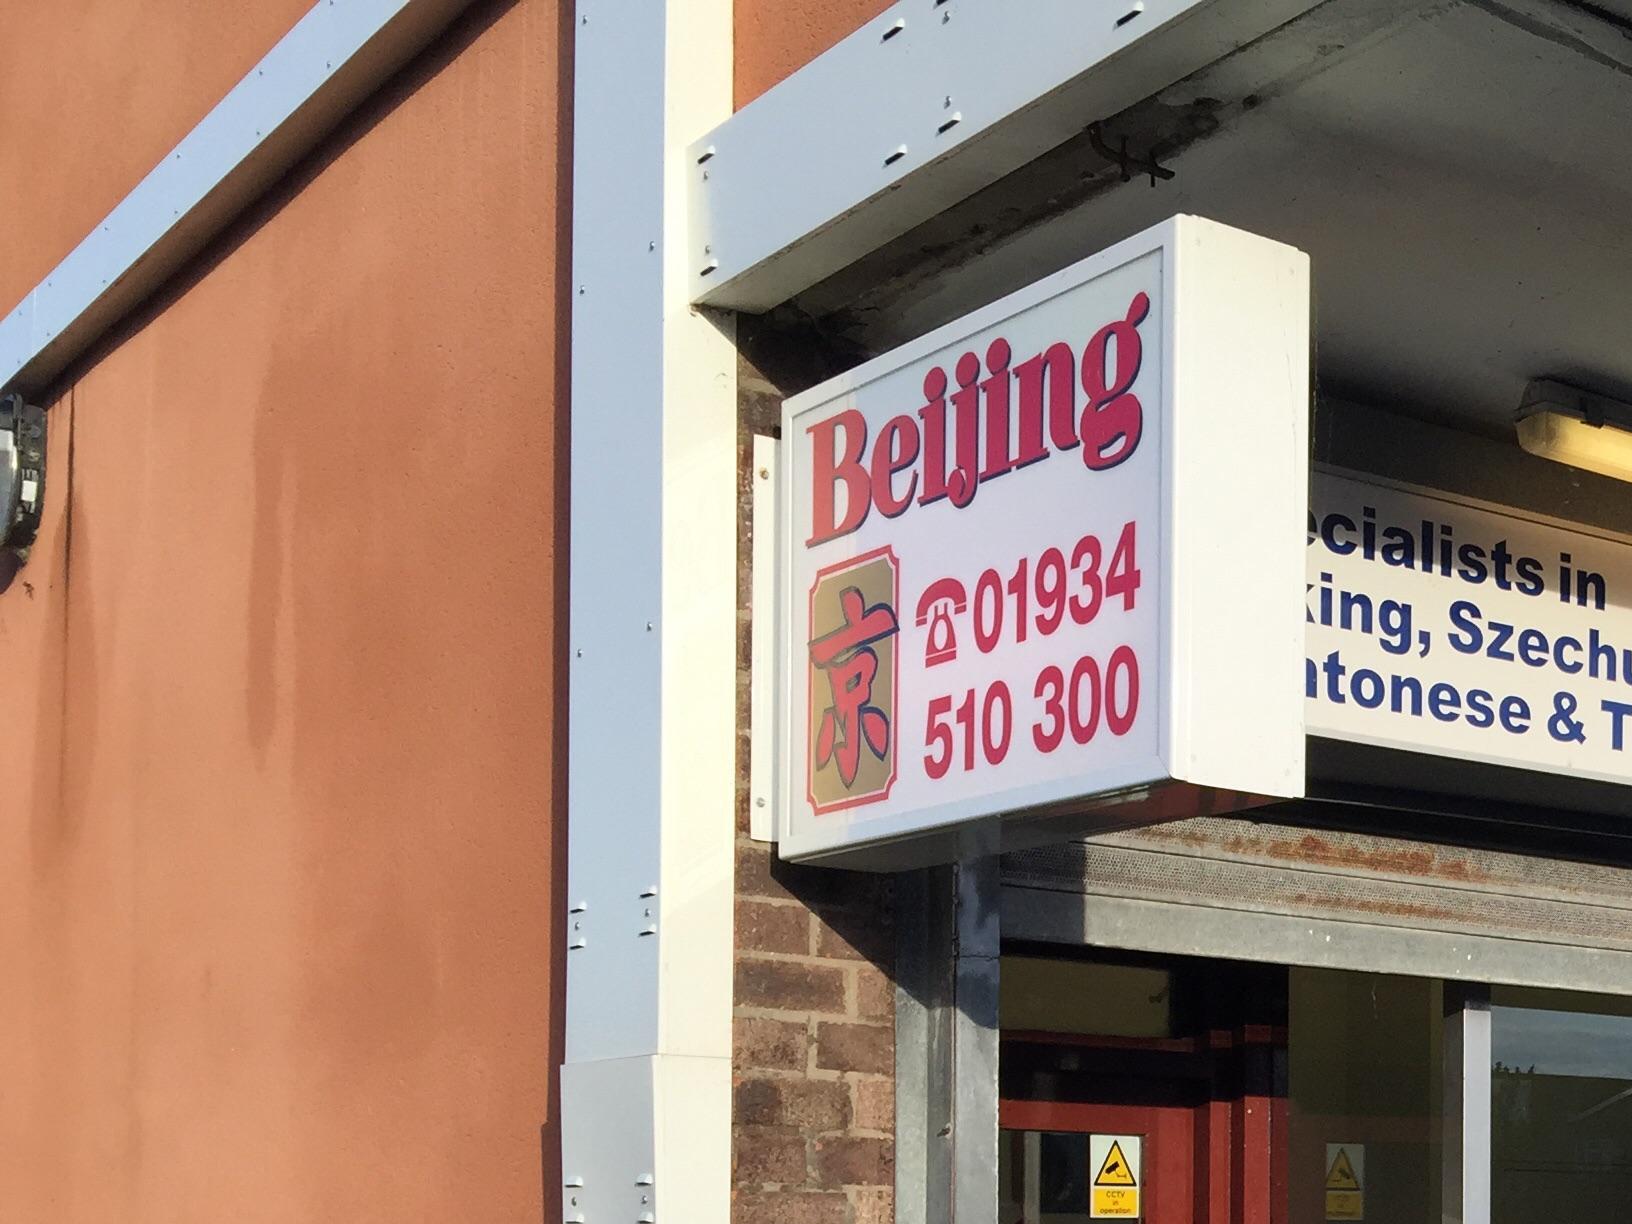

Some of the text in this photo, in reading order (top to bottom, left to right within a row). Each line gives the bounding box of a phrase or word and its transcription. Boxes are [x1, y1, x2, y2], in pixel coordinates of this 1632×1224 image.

[805, 291, 1151, 548] Beijing
[973, 520, 1141, 655] 01934
[1559, 552, 1606, 611] in
[808, 585, 900, 790] 京
[924, 645, 1140, 780] 510 300
[1547, 690, 1587, 745] &
[1106, 1190, 1126, 1198] CCTV
